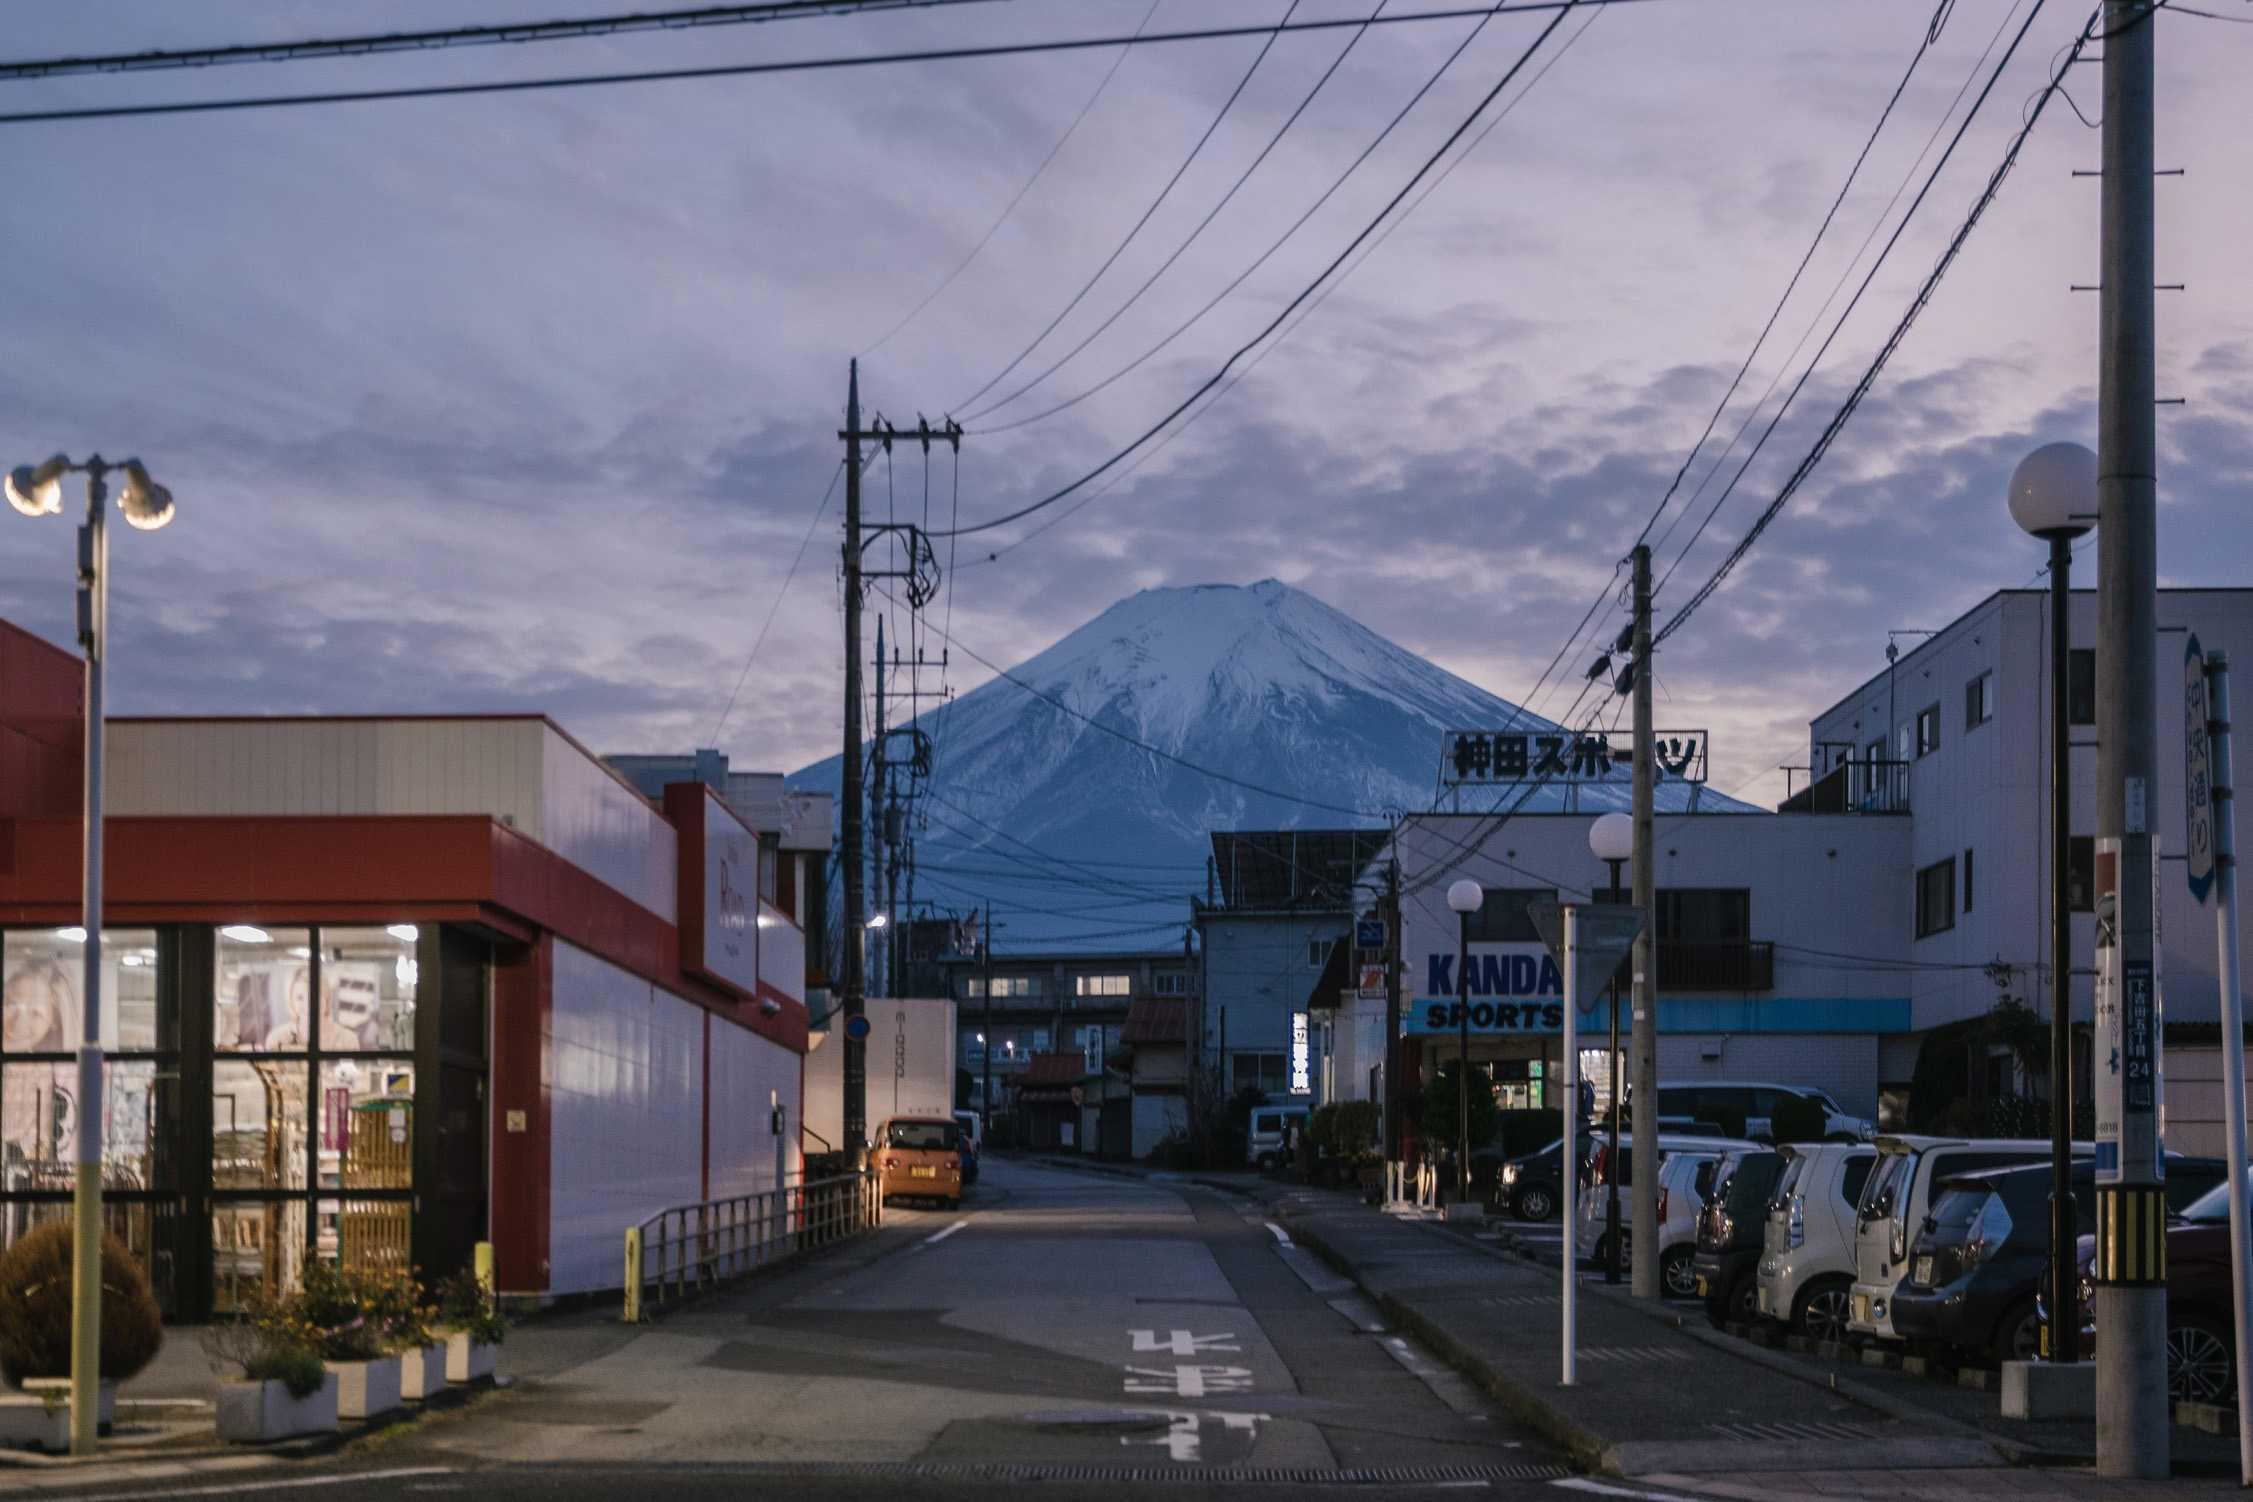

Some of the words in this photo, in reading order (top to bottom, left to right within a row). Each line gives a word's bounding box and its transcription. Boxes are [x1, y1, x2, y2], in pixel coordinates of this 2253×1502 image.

[1427, 953, 1564, 996] KANDA
[1426, 1001, 1564, 1029] SPORTS
[2128, 1061, 2149, 1078] 24
